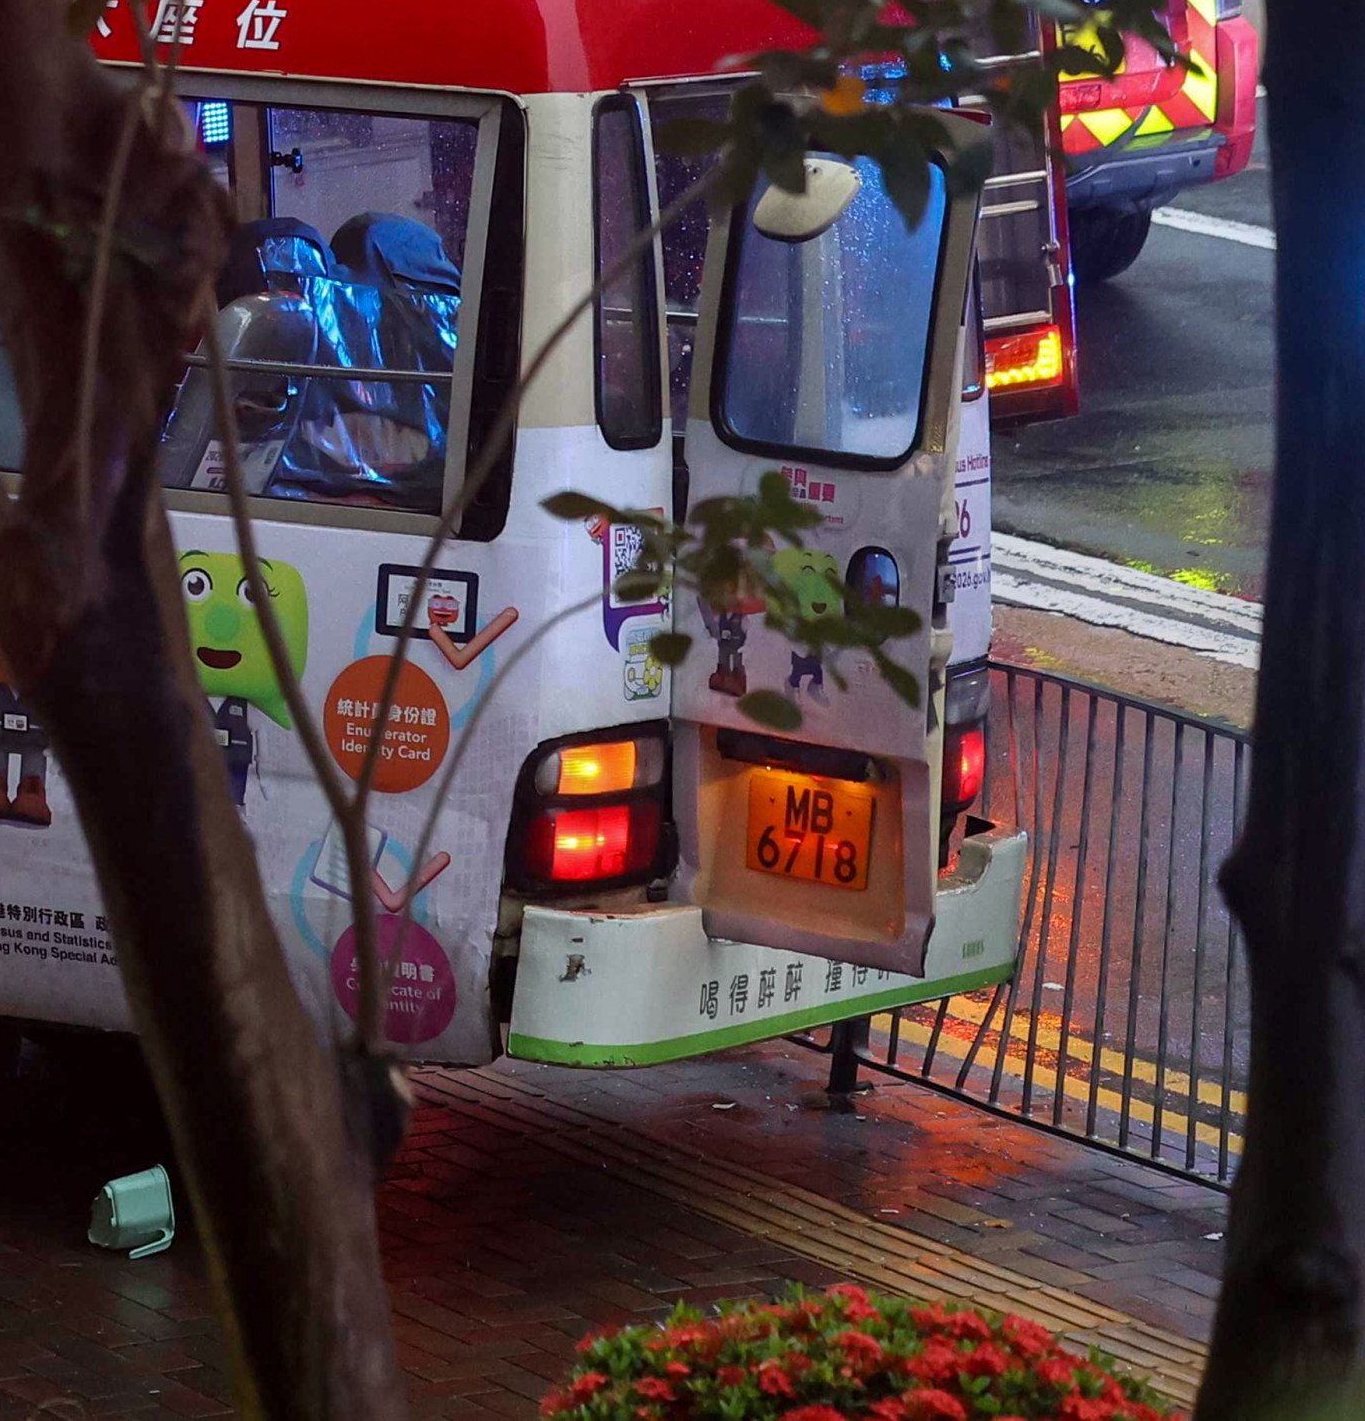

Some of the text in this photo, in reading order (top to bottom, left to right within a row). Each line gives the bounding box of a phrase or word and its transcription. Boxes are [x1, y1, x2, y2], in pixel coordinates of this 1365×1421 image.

[345, 722, 428, 744] Enuerator
[341, 738, 431, 761] Idety Card
[785, 785, 834, 835] MB
[757, 825, 857, 883] 6718
[26, 929, 50, 943] and
[13, 941, 47, 960] Kong
[50, 947, 97, 963] Special
